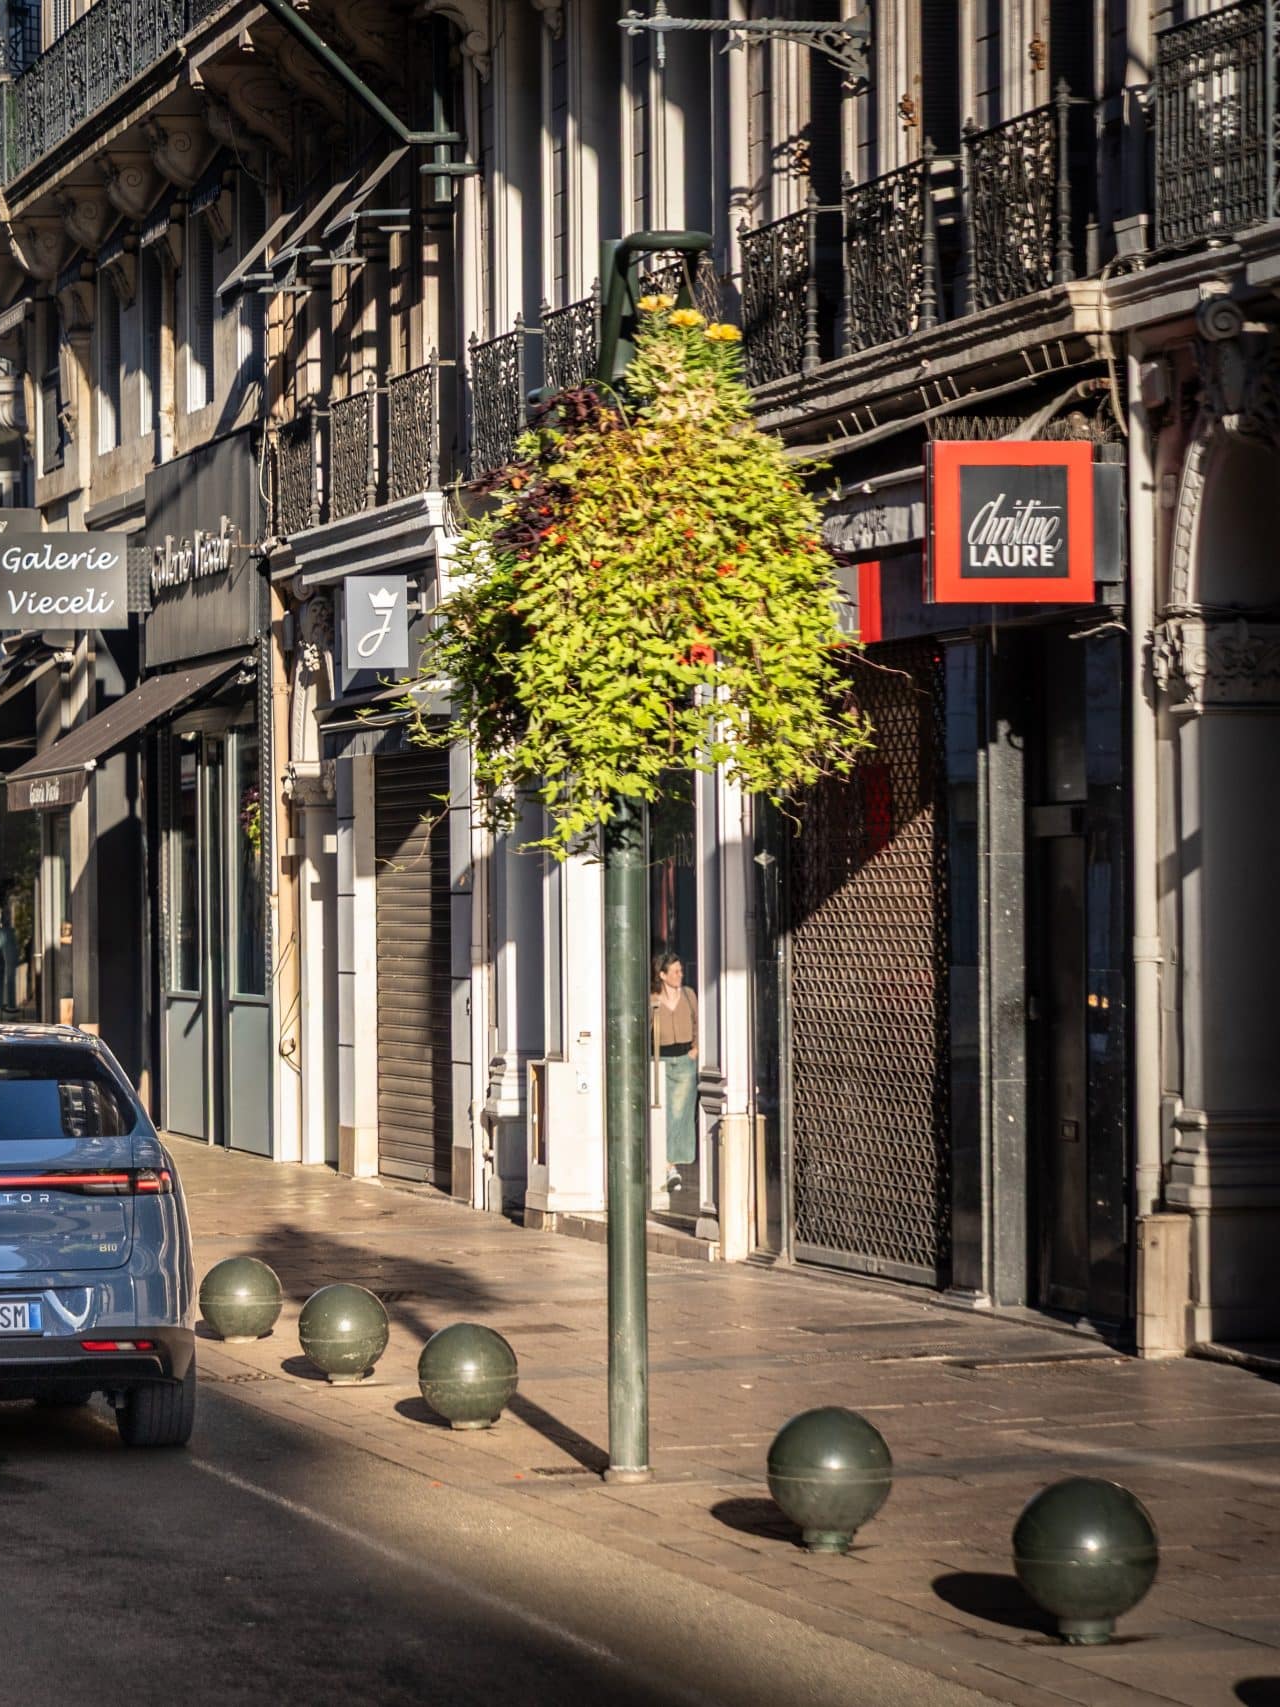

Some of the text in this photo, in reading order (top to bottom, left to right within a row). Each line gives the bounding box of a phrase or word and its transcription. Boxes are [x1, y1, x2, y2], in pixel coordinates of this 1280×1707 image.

[967, 493, 1062, 552] Christine
[2, 544, 119, 574] Galerie
[969, 545, 1055, 567] LAURE
[7, 588, 115, 615] Vieceli
